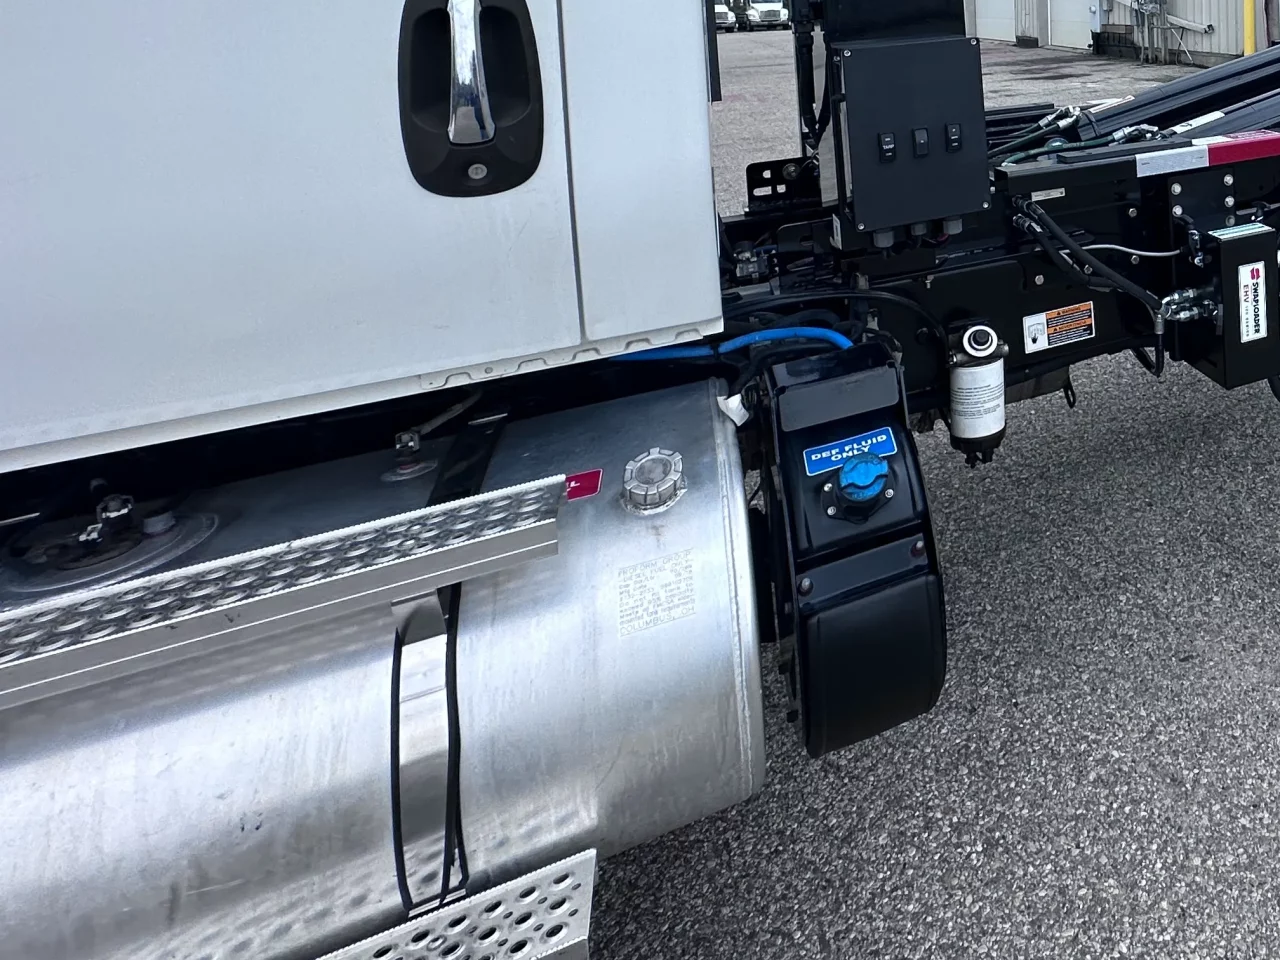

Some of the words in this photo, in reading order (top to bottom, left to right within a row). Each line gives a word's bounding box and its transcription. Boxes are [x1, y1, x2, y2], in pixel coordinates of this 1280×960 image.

[1252, 281, 1261, 335] SWAPLOADER
[811, 447, 840, 461] DEF
[844, 434, 888, 452] FLUID
[830, 445, 870, 461] ONLY
[617, 560, 658, 578] PROFORM
[662, 551, 692, 565] GROUP
[680, 605, 695, 615] OH
